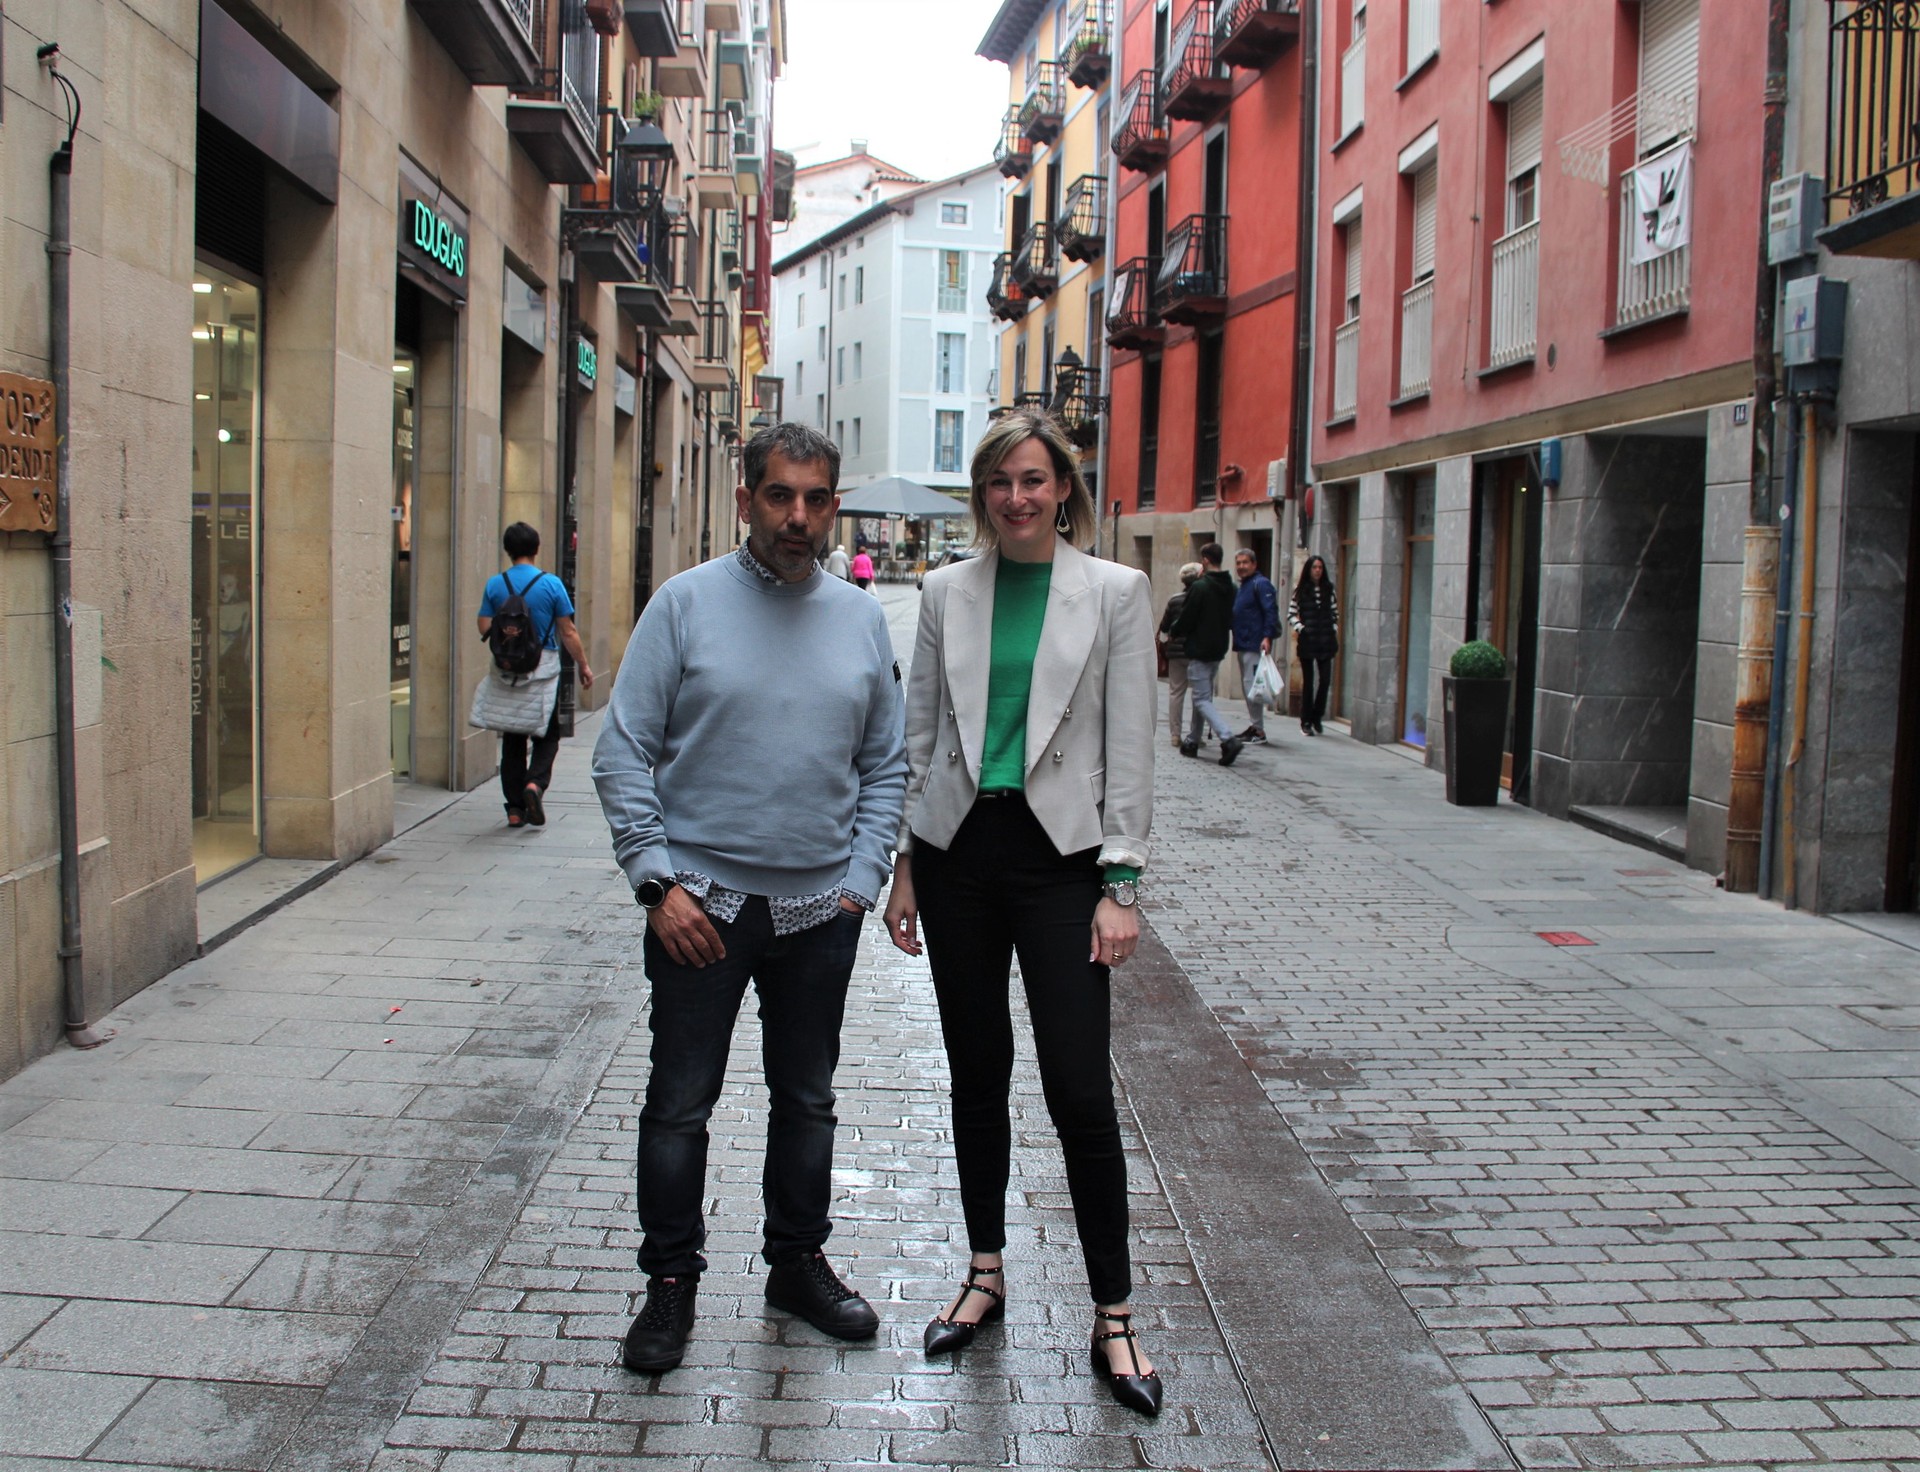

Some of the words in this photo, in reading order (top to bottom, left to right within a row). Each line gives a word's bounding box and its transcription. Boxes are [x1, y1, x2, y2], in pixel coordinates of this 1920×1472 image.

[414, 199, 465, 278] DOUGLAS
[0, 388, 36, 438] OR
[192, 618, 202, 716] MUGLER
